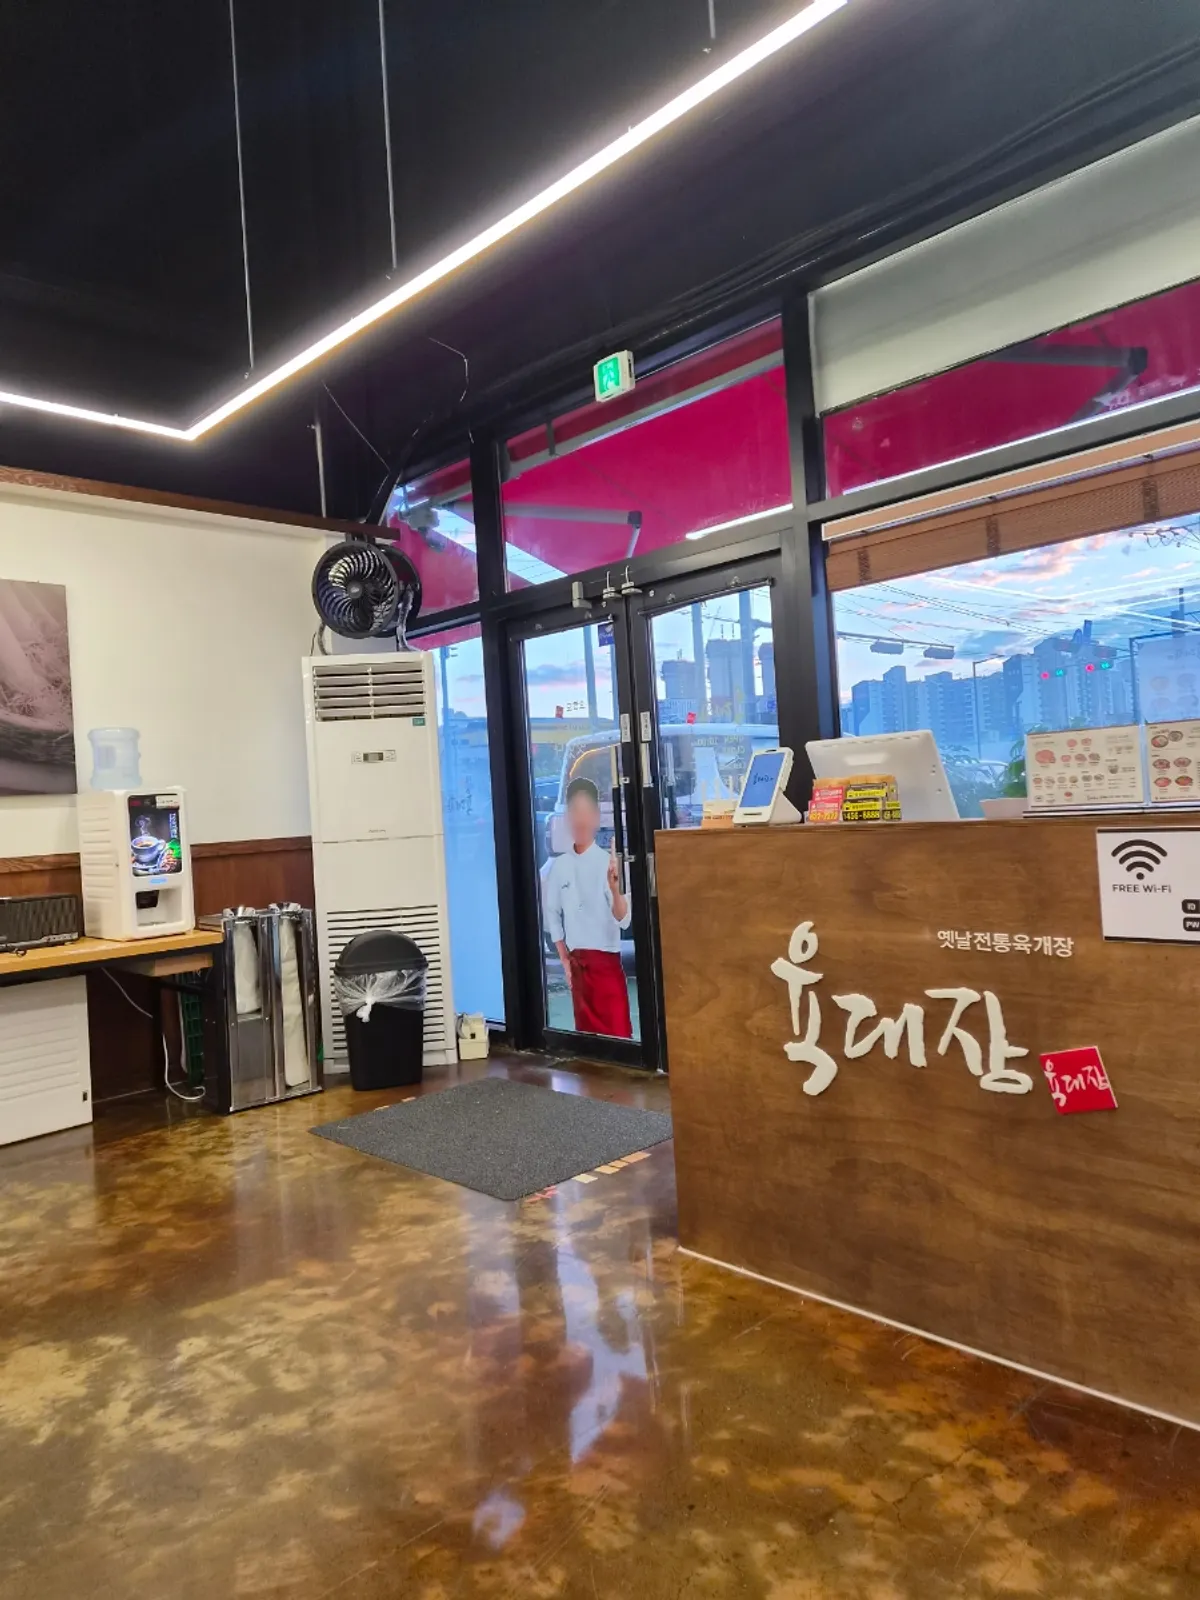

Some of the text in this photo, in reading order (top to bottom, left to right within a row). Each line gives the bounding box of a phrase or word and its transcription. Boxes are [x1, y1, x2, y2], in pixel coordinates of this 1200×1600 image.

[1112, 884, 1172, 893] FREE Wi-Fi
[770, 921, 1033, 1096] 육대장
